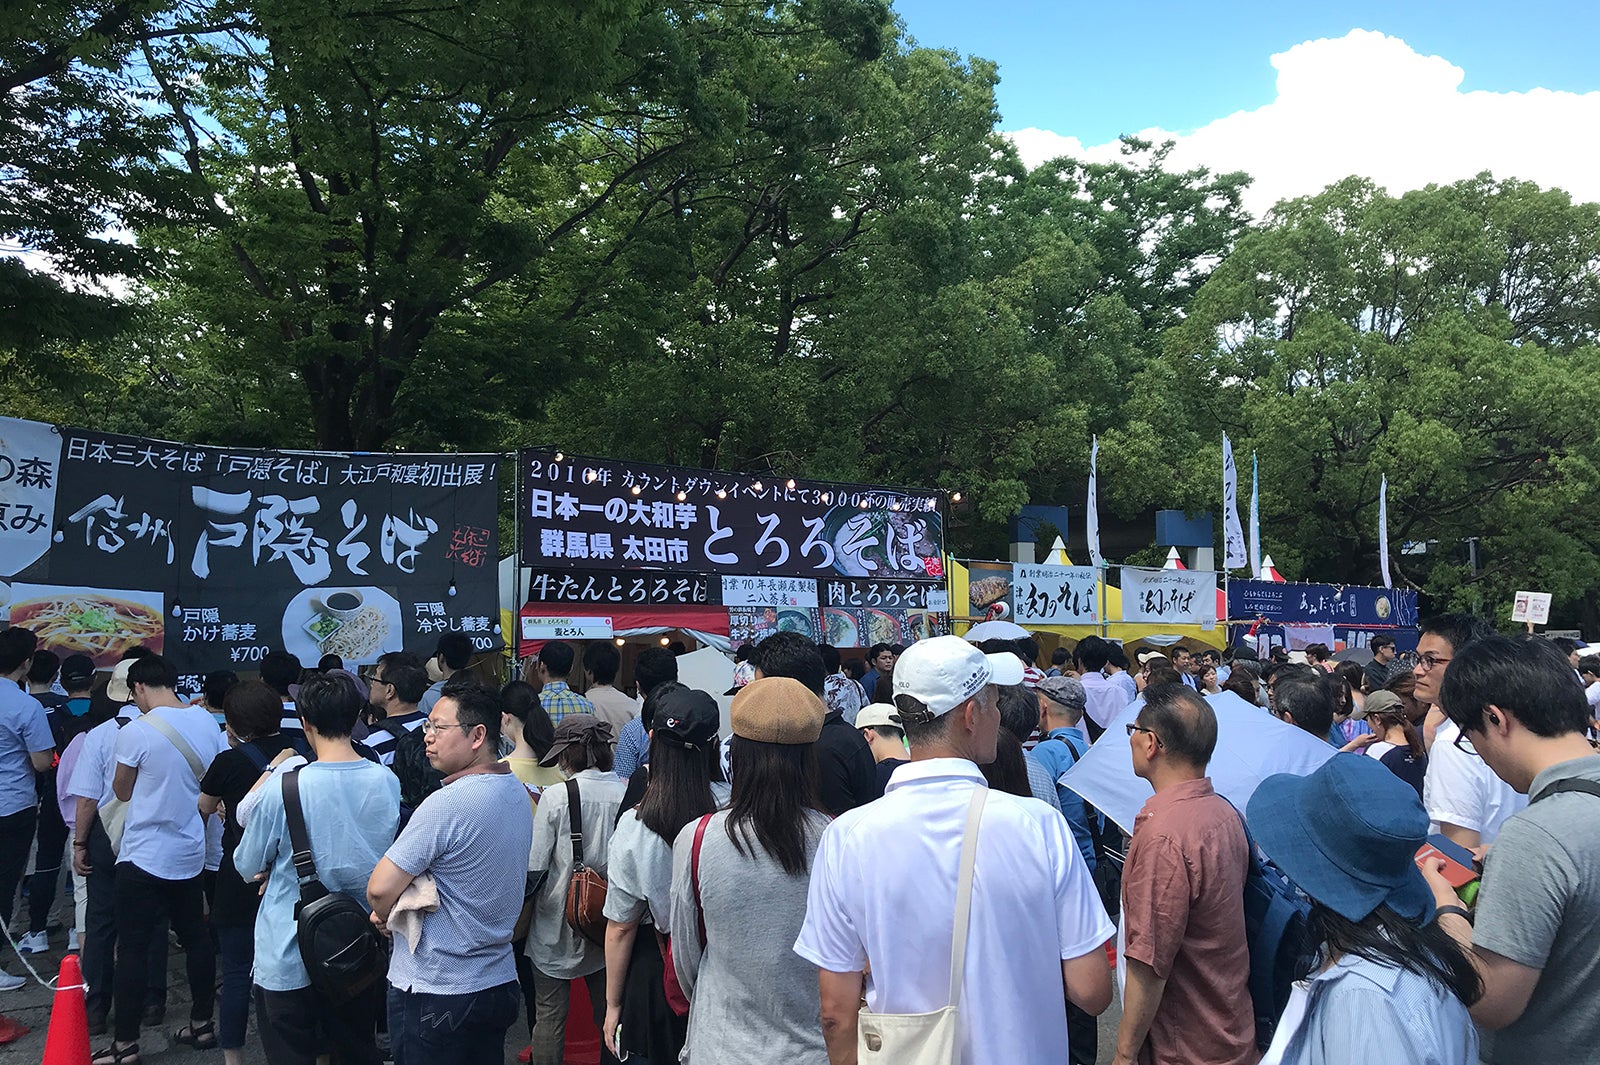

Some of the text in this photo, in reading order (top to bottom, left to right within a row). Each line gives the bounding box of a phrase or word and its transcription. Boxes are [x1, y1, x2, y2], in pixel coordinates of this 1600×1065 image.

[531, 488, 697, 530] 日本一の大和芋
[68, 493, 175, 565] 信州
[191, 485, 438, 586] 戸隠そば
[704, 505, 928, 572] とろろそば
[540, 528, 689, 564] 群馬県 太田市
[414, 602, 447, 617] 戸隠
[1024, 581, 1096, 619] 幻のそば
[1145, 588, 1196, 616] 幻のそば
[183, 608, 221, 624] 戸隠
[416, 616, 491, 634] 冷やし蕎麦
[183, 623, 257, 642] かけ蕎麦
[554, 627, 584, 637] 麦とろ人
[469, 636, 493, 650] 700
[230, 646, 270, 662] ¥700
